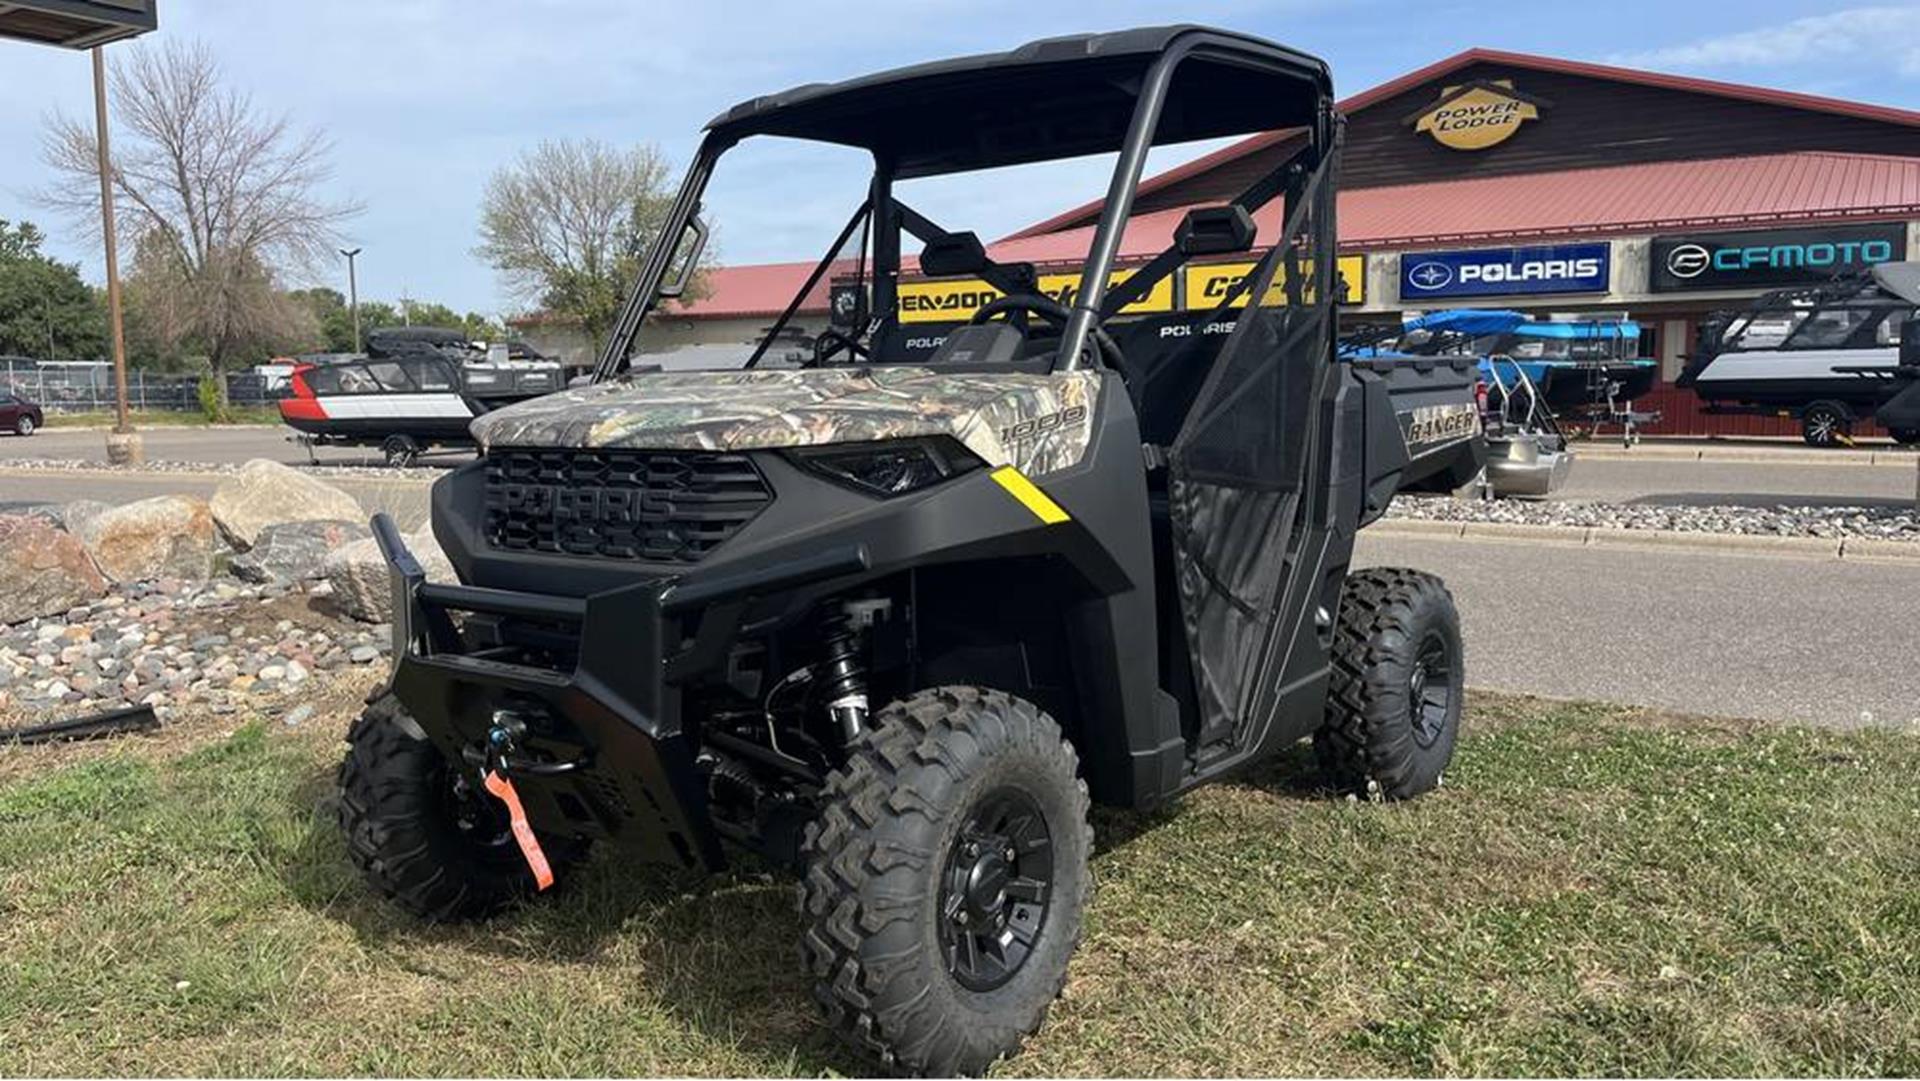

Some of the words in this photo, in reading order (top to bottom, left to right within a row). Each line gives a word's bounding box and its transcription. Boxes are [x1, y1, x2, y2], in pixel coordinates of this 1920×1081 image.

[1434, 101, 1520, 122] POWER
[1439, 113, 1516, 132] LODGE
[1713, 240, 1892, 270] CFMOTO
[1460, 259, 1598, 283] POLARIS
[1160, 321, 1237, 338] POLRIS
[1001, 405, 1087, 441] 1000
[1409, 412, 1474, 442] RANGER
[505, 486, 677, 522] POLARIS
